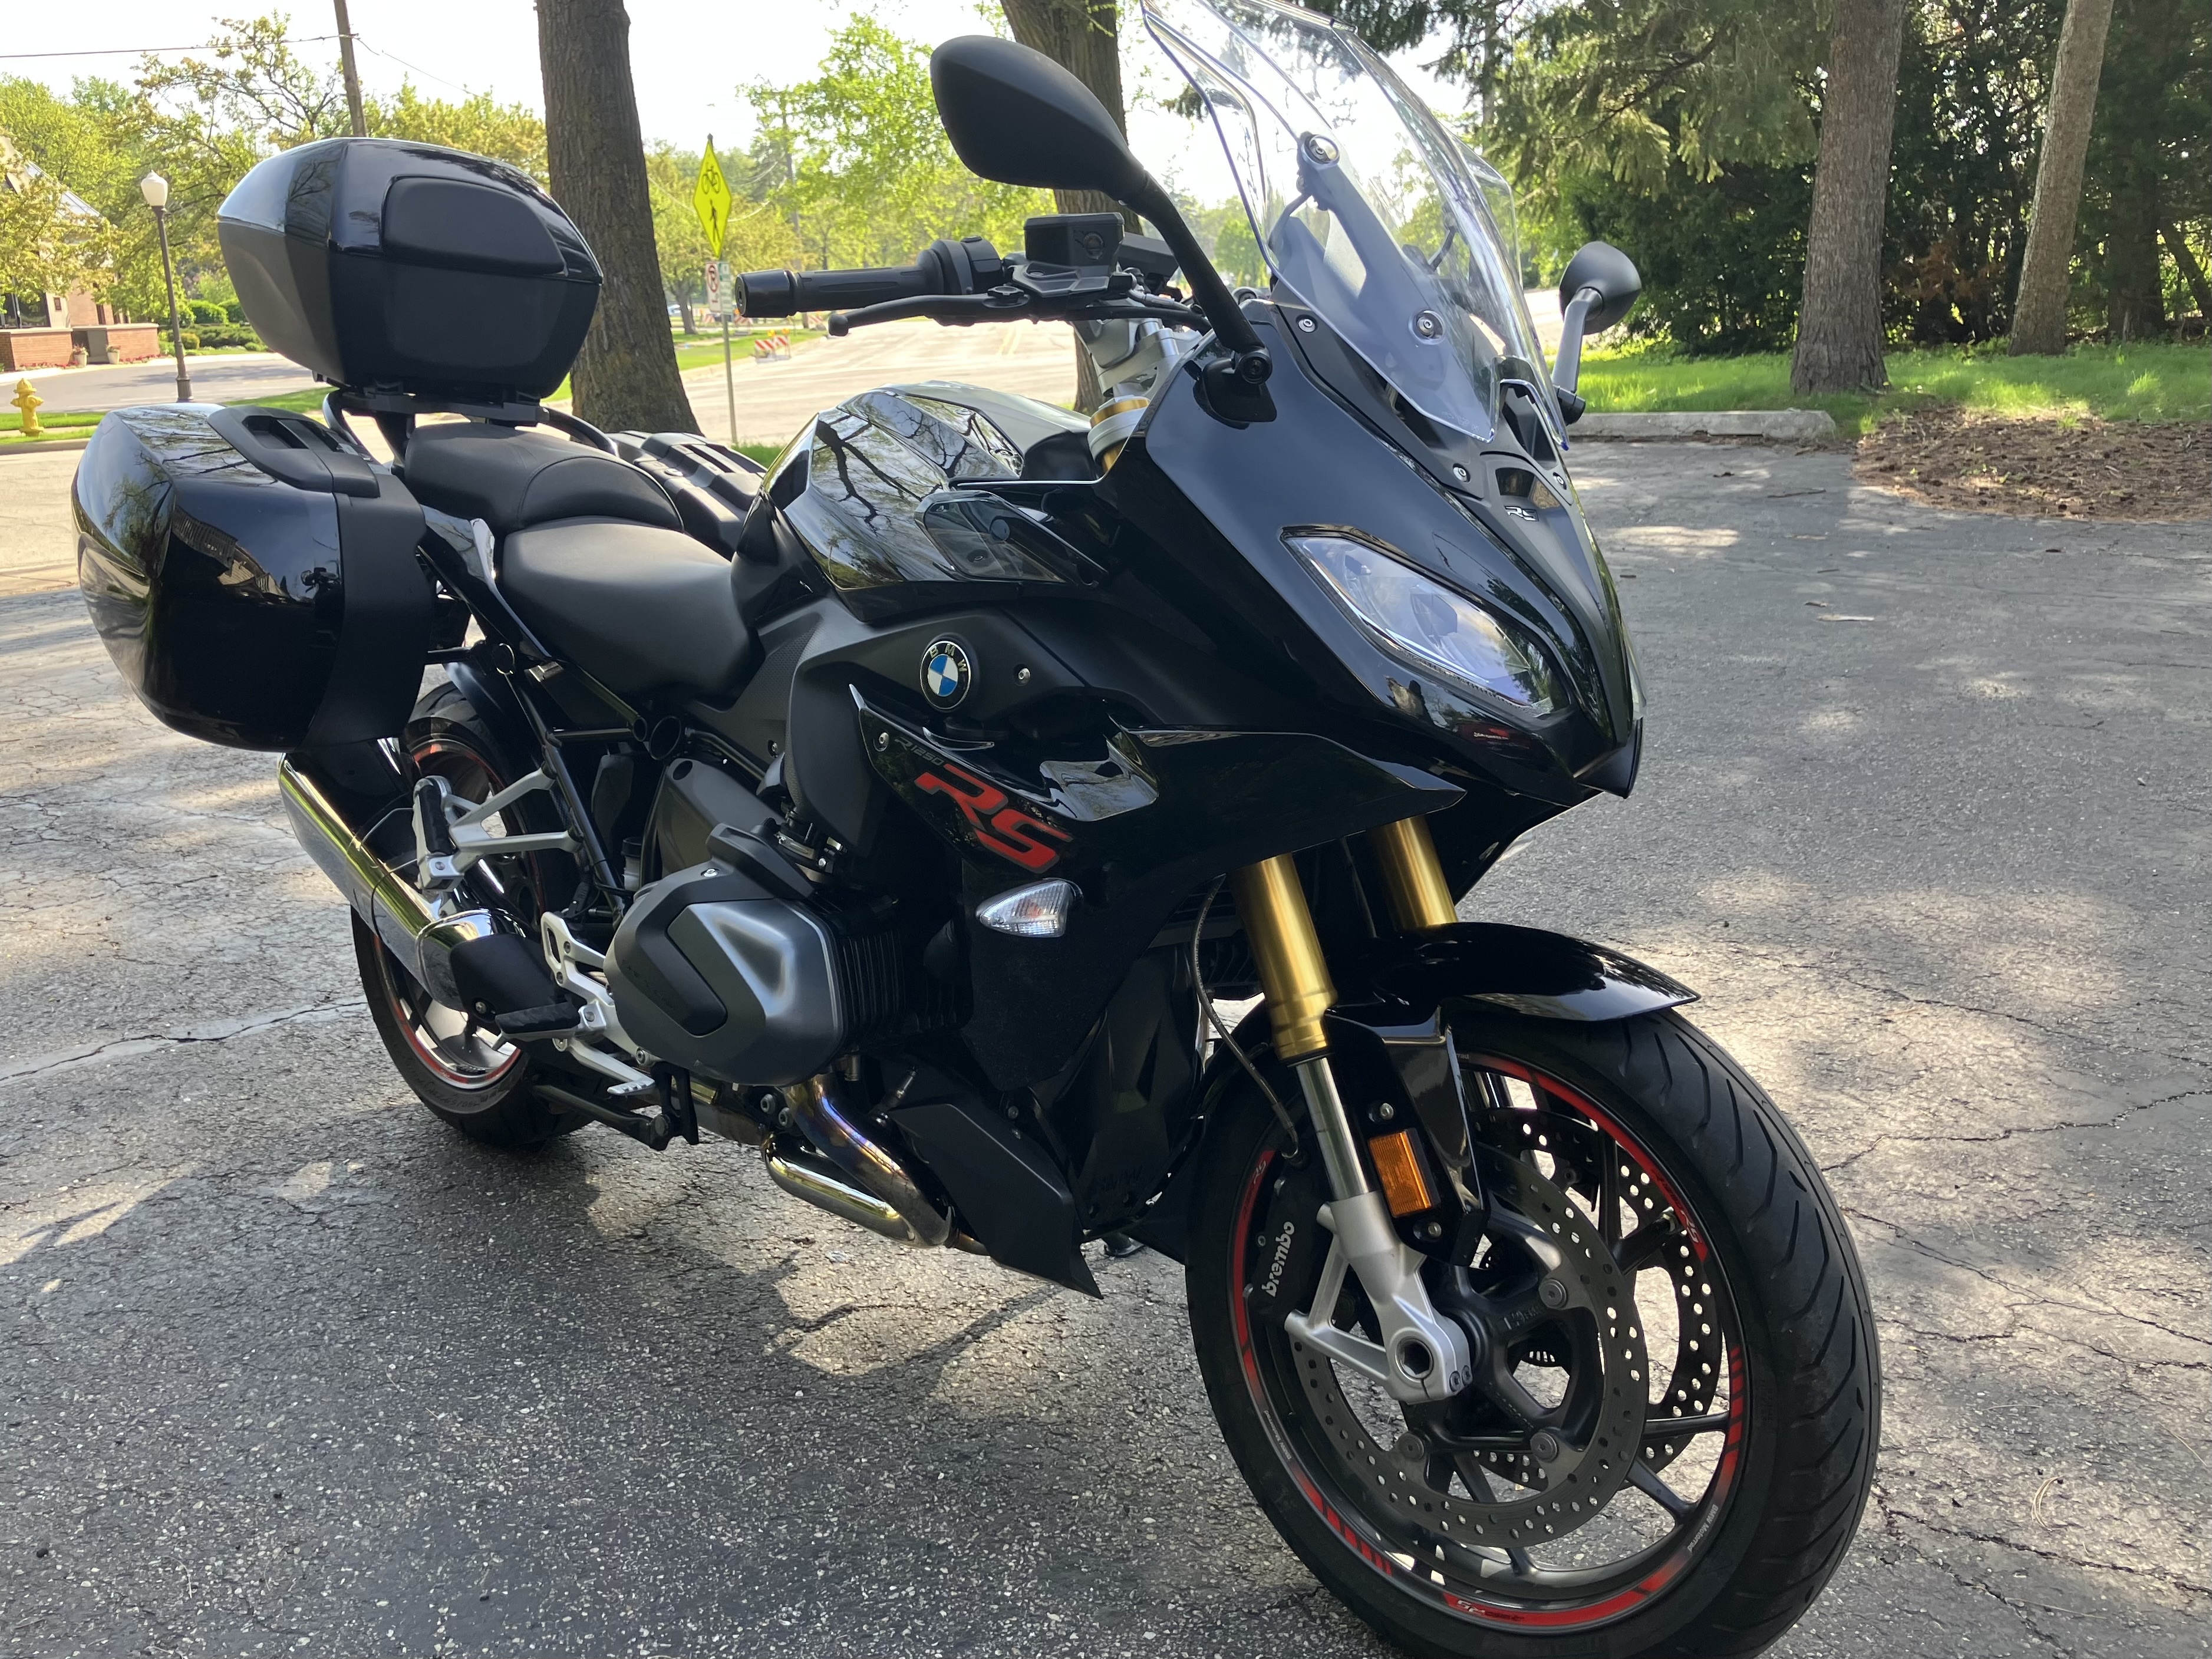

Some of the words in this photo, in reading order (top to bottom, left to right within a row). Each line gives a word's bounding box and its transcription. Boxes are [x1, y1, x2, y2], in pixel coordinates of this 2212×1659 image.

[1504, 506, 1540, 522] RS
[929, 643, 968, 672] BMW
[894, 737, 944, 766] R1250
[914, 763, 1074, 874] RS
[1261, 1221, 1295, 1297] brembo
[1706, 1503, 1719, 1525] BMW
[1687, 1522, 1709, 1552] Motorrad
